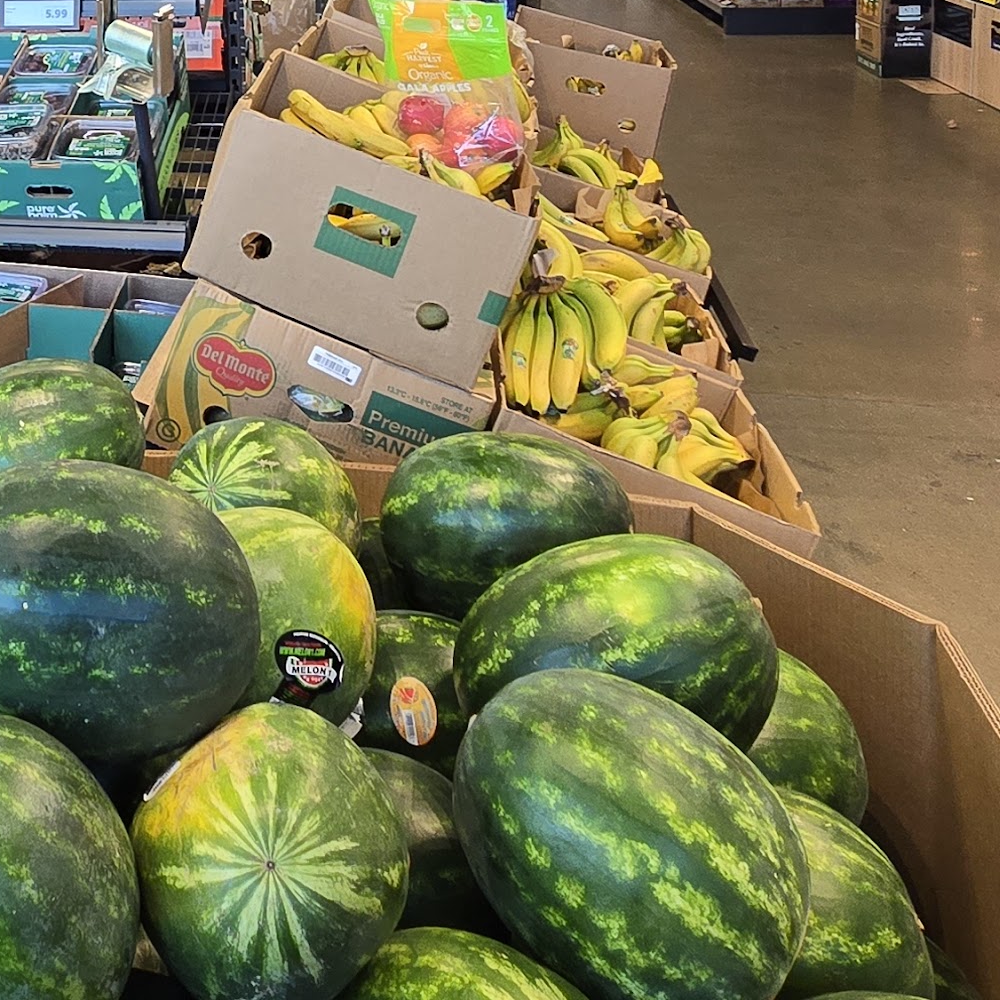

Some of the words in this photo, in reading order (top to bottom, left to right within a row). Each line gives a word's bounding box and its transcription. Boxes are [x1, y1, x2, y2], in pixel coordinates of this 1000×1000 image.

[44, 8, 68, 20] 5.99
[485, 15, 494, 28] 2
[408, 68, 454, 82] Organic
[397, 83, 428, 93] GALA
[431, 82, 472, 93] APPLES
[26, 205, 55, 214] pure
[201, 343, 225, 365] Del
[224, 353, 270, 385] Monte
[215, 366, 245, 387] Quality
[440, 397, 464, 411] STORE
[463, 406, 474, 414] AT
[368, 409, 436, 445] Premiu
[361, 428, 417, 459] BANA
[291, 666, 327, 676] MELON
